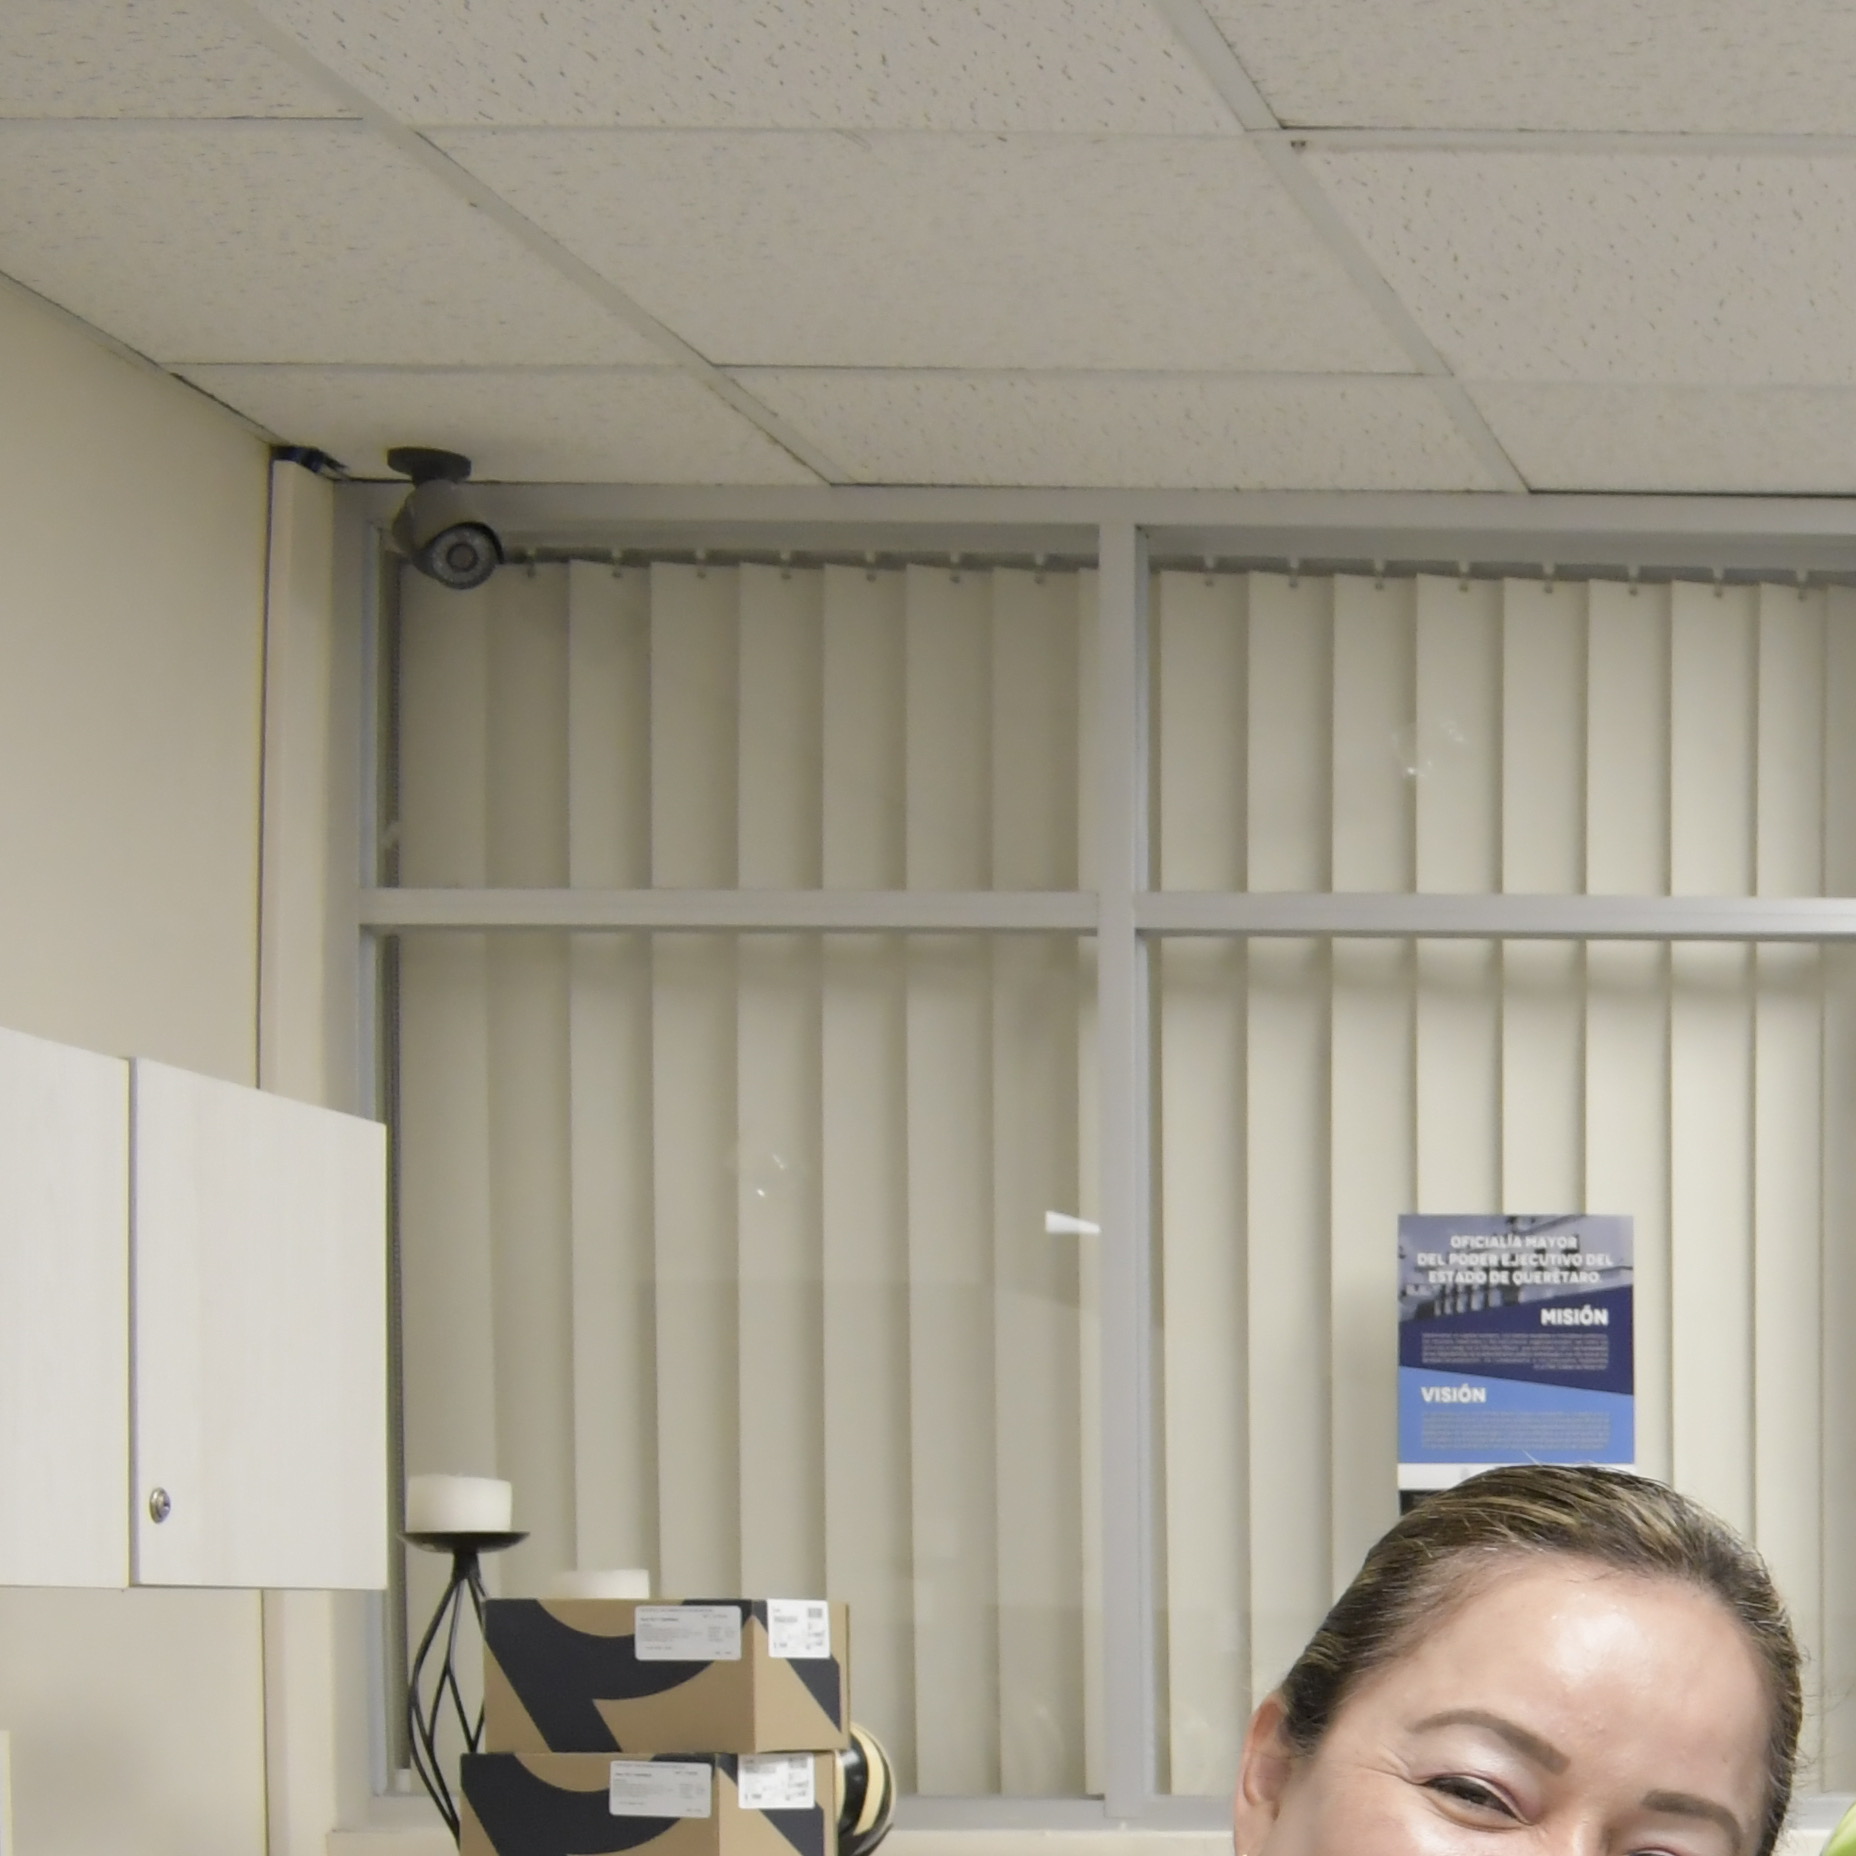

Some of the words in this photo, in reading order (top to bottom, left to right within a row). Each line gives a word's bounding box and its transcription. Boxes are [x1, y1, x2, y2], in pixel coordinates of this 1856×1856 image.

[1450, 1234, 1521, 1249] OFICIALÍA
[1525, 1235, 1577, 1249] MAYOR
[1417, 1253, 1444, 1266] DEL
[1449, 1253, 1498, 1267] PODER
[1501, 1253, 1582, 1267] EJECUTIVO
[1585, 1253, 1613, 1266] DEL
[1428, 1271, 1486, 1284] ESTADO
[1489, 1271, 1510, 1284] DE
[1541, 1305, 1609, 1326] MISIÓN
[1421, 1384, 1487, 1404] VISIÓN
